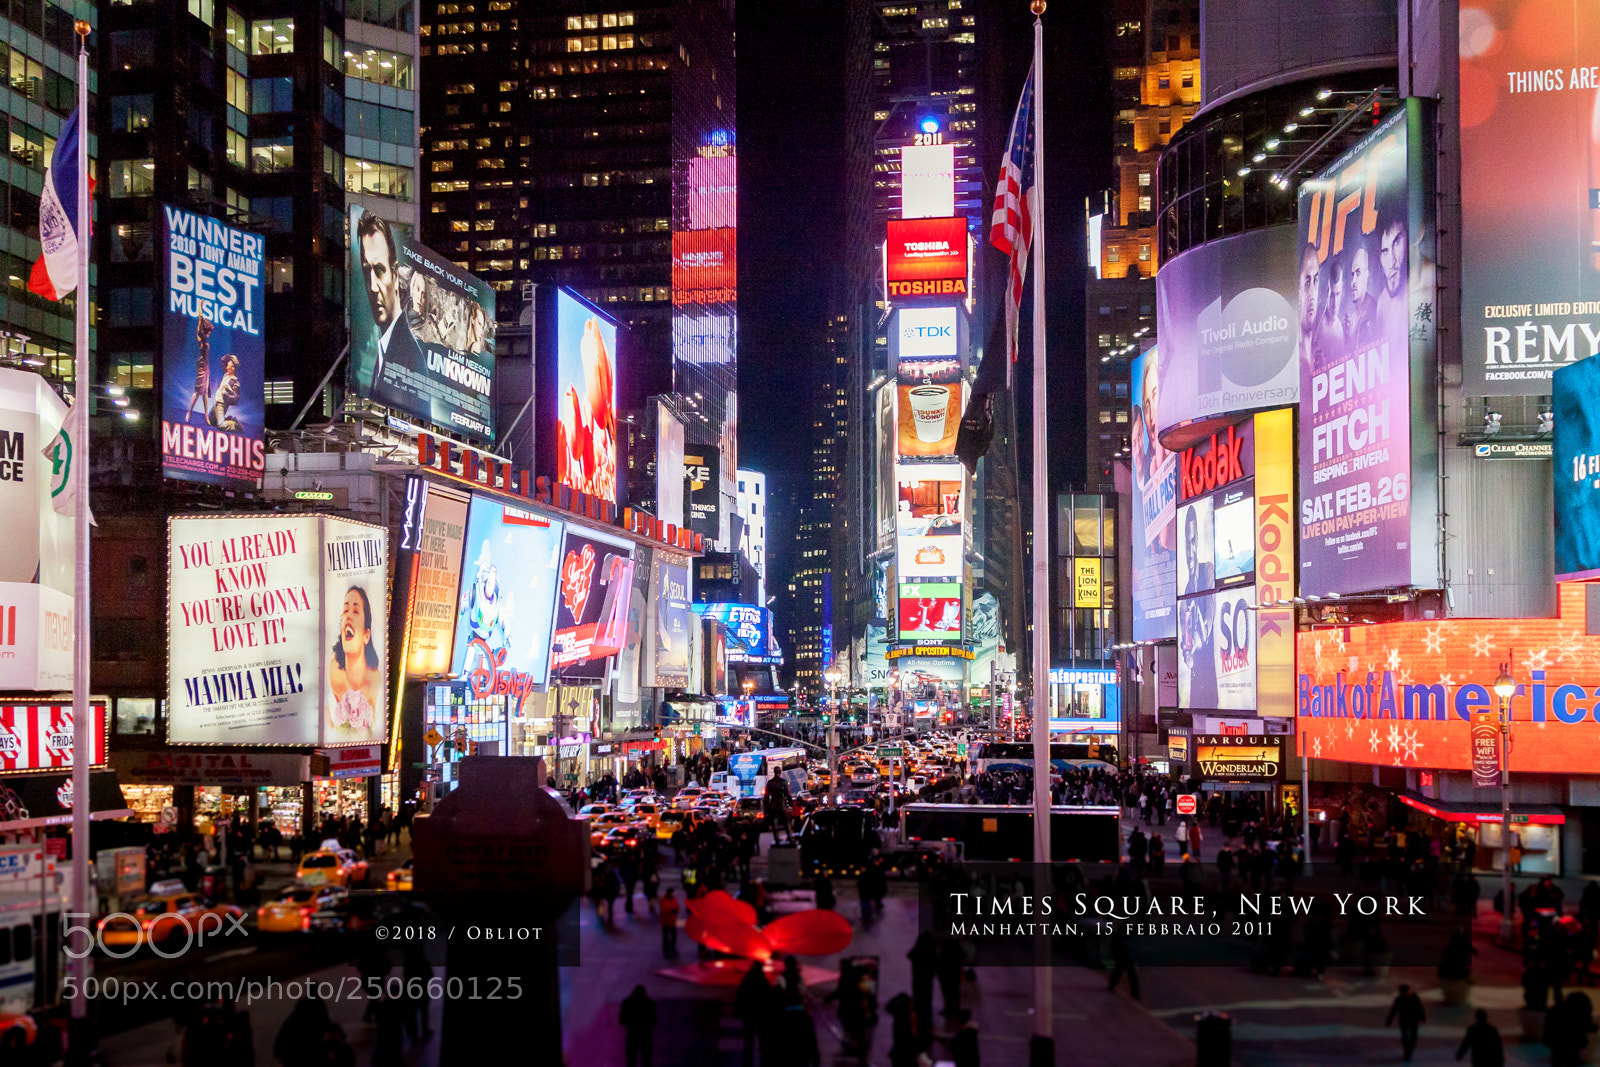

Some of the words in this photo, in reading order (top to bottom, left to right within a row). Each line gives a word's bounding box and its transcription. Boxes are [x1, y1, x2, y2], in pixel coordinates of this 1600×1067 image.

[1507, 68, 1564, 94] THINGS
[1569, 66, 1600, 90] ARE
[914, 133, 942, 146] 2011
[1326, 149, 1354, 177] FIGHTING
[1354, 107, 1406, 155] CHAMPIONSHIP
[1307, 133, 1397, 265] UFC
[165, 206, 262, 261] WINNER!
[904, 241, 949, 252] TOSHIBA
[170, 232, 196, 256] 2010
[200, 242, 226, 265] TONY
[227, 252, 259, 276] AWARD
[402, 246, 423, 265] TAKE
[423, 258, 445, 278] BACK
[445, 270, 464, 290] YOUR
[170, 251, 259, 312] BEST
[888, 279, 966, 296] TOSHIBA
[170, 290, 259, 335] MUSICAL
[1484, 304, 1533, 319] EXCLUSIVE
[1534, 302, 1571, 317] LIMITED
[915, 326, 951, 337] TDK
[1201, 323, 1236, 345] Tivoli
[1241, 315, 1289, 337] Audio
[1483, 320, 1600, 365] RÉMY
[1200, 347, 1211, 355] The
[1212, 341, 1234, 355] Original
[1234, 338, 1254, 350] Radio
[1254, 334, 1289, 347] Company
[427, 349, 492, 397] UNKNOWN
[448, 349, 465, 364] LIAM
[465, 357, 491, 377] NEESON
[1312, 342, 1390, 415] PENN
[1198, 396, 1219, 411] 10th
[1222, 386, 1299, 406] Anniversary
[1342, 399, 1354, 414] VS
[450, 411, 485, 434] FEBRUARY
[1312, 398, 1390, 465] FITCH
[162, 420, 266, 471] MEMPHIS
[1180, 425, 1244, 501] Kodak
[1313, 460, 1348, 485] BISPING
[1353, 447, 1390, 472] RIVERA
[1573, 453, 1587, 482] 16
[691, 503, 716, 513] THINGS
[1143, 488, 1161, 528] HALL
[1302, 492, 1334, 526] SAT.
[1335, 480, 1378, 517] FEB.
[1378, 472, 1408, 506] 26
[425, 517, 446, 538] YOU'VE
[446, 523, 463, 541] MADE
[624, 507, 706, 557] BUILDING
[1302, 522, 1320, 540] LIVE
[1321, 518, 1335, 536] ON
[1336, 500, 1409, 532] PAY-PER-VIEW
[179, 541, 214, 570] YOU
[219, 528, 299, 565] ALREADY
[326, 540, 362, 572] MAMMA
[362, 538, 382, 568] MIA!
[422, 533, 430, 550] IT
[420, 551, 434, 567] BUT
[434, 554, 449, 571] WILL
[1080, 567, 1095, 575] THE
[1258, 493, 1290, 638] Kodak
[214, 562, 269, 594] KNOW
[419, 568, 433, 584] YOU
[433, 571, 441, 586] BE
[441, 572, 456, 588] ABLE
[669, 580, 686, 601] SEOUL
[902, 585, 921, 597] FX
[1078, 575, 1098, 588] LION
[179, 594, 246, 627] YOU'RE
[249, 585, 312, 618] GONNA
[418, 584, 426, 601] TO
[426, 586, 448, 603] RETIRE
[1078, 588, 1098, 601] KING
[415, 601, 452, 620] ANYWHERE?
[211, 618, 259, 652] LOVE
[263, 617, 288, 646] IT!
[1220, 597, 1250, 661] SO
[915, 646, 951, 656] OPPOSITION
[932, 660, 956, 668] Optima
[1220, 643, 1250, 674] Kodak
[184, 670, 258, 708] MAMMA
[260, 662, 304, 698] MIA!
[1050, 668, 1117, 685] AÉROPOSTALE
[1298, 669, 1348, 720] Bank
[1352, 671, 1379, 720] of
[1377, 668, 1600, 725] Americ
[52, 735, 74, 748] FRiDA
[1196, 736, 1281, 745] MARQUIS
[1475, 738, 1496, 747] FREE
[1476, 746, 1495, 755] WIFI
[148, 753, 253, 769] DIGITAL
[1199, 761, 1278, 777] WONDERLAND
